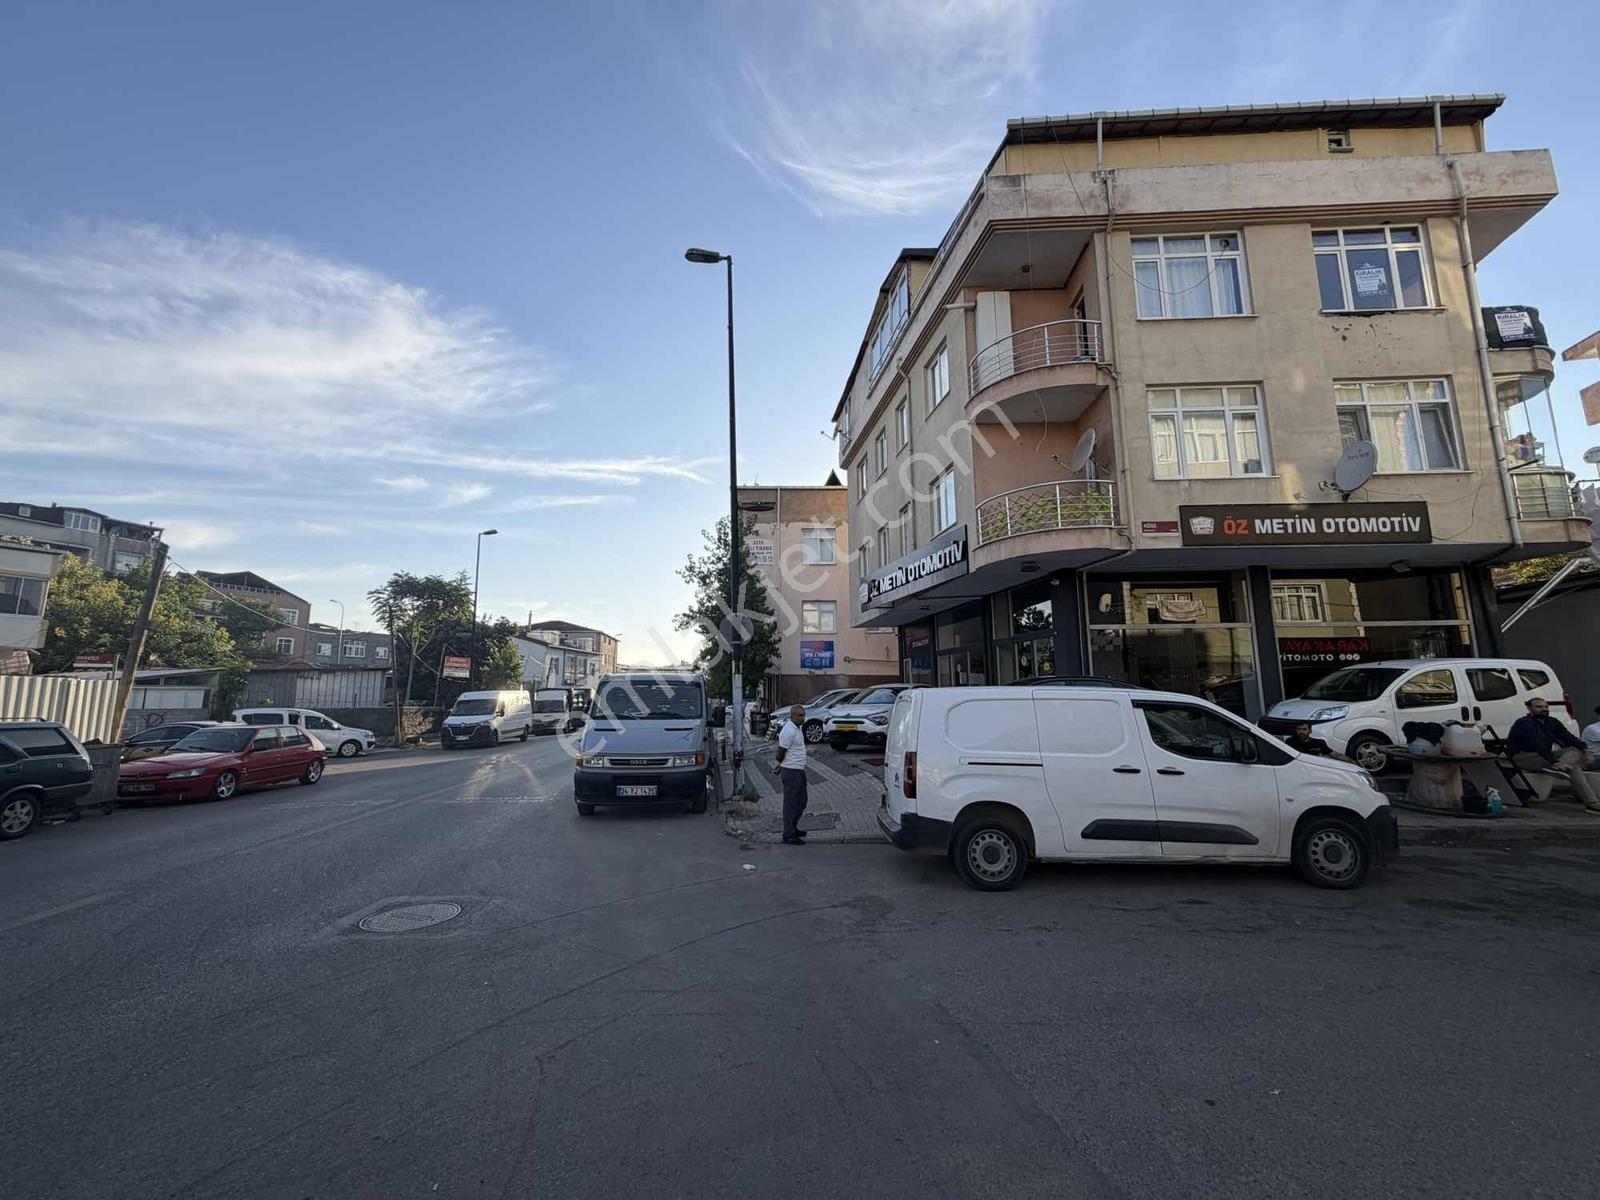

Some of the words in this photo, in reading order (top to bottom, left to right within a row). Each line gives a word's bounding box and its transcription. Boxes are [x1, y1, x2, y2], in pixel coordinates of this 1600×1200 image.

[1223, 515, 1248, 534] ÖZ
[1255, 514, 1316, 534] METİN
[1322, 513, 1421, 533] OTOMOTİV
[879, 566, 906, 595] METİN
[907, 540, 963, 581] OTOMOTİV
